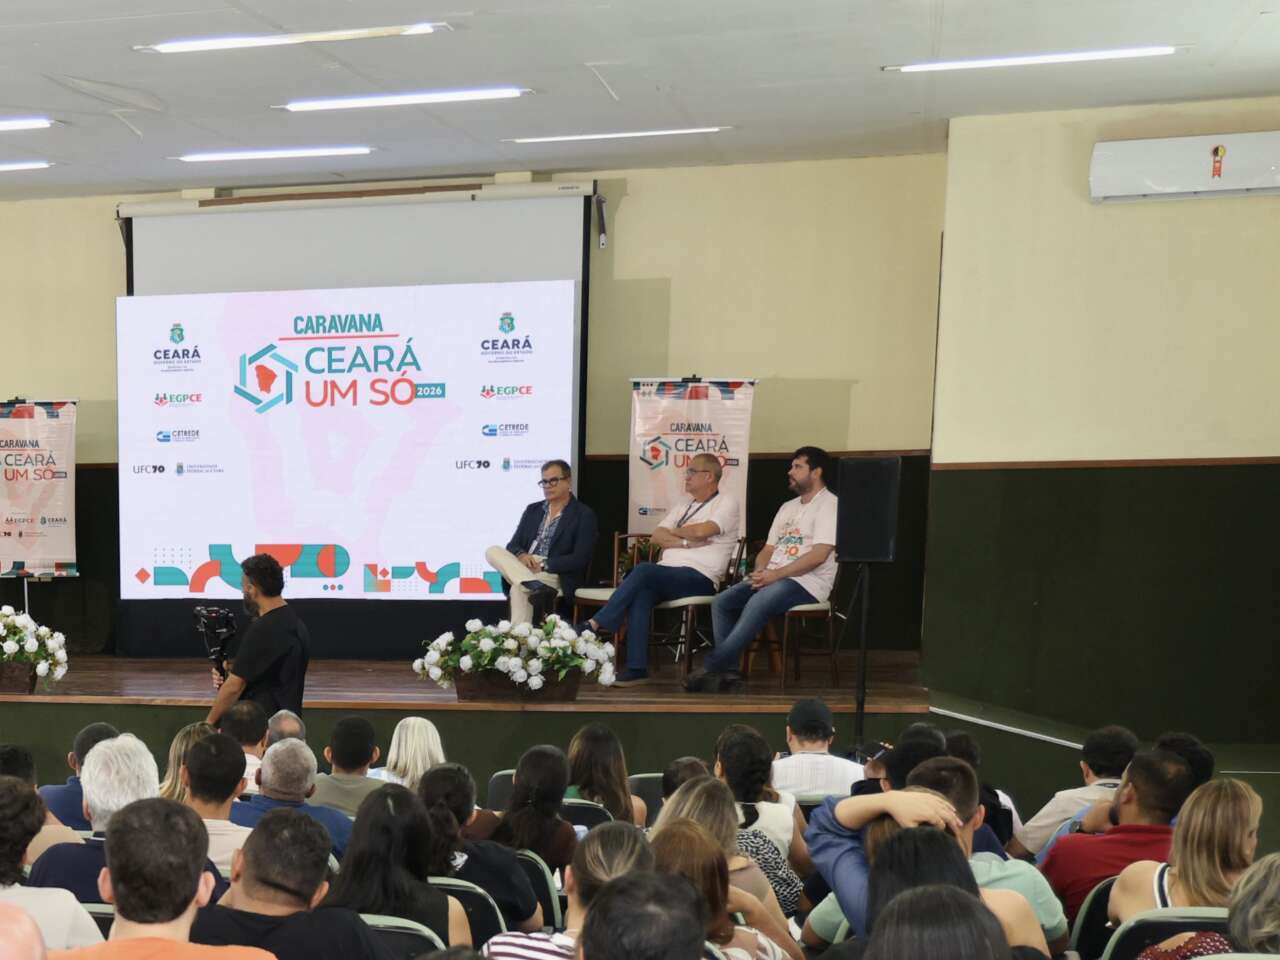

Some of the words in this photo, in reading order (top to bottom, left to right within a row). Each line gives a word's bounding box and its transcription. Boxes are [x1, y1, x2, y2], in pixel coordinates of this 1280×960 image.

[294, 313, 383, 335] CARAVANA
[480, 334, 532, 351] CEARÁ
[153, 344, 201, 360] CEARÁ
[305, 337, 422, 374] CEARÁ
[304, 379, 358, 408] UM
[369, 370, 416, 406] SÓ
[416, 386, 443, 396] 2026
[496, 385, 533, 395] EGPCE
[169, 393, 202, 403] EGPCE
[670, 422, 713, 433] CARAVANA
[0, 439, 40, 449] CARAVANA
[674, 435, 729, 453] CEARÁ
[4, 449, 57, 467] CEARÁ
[4, 467, 29, 481] UM
